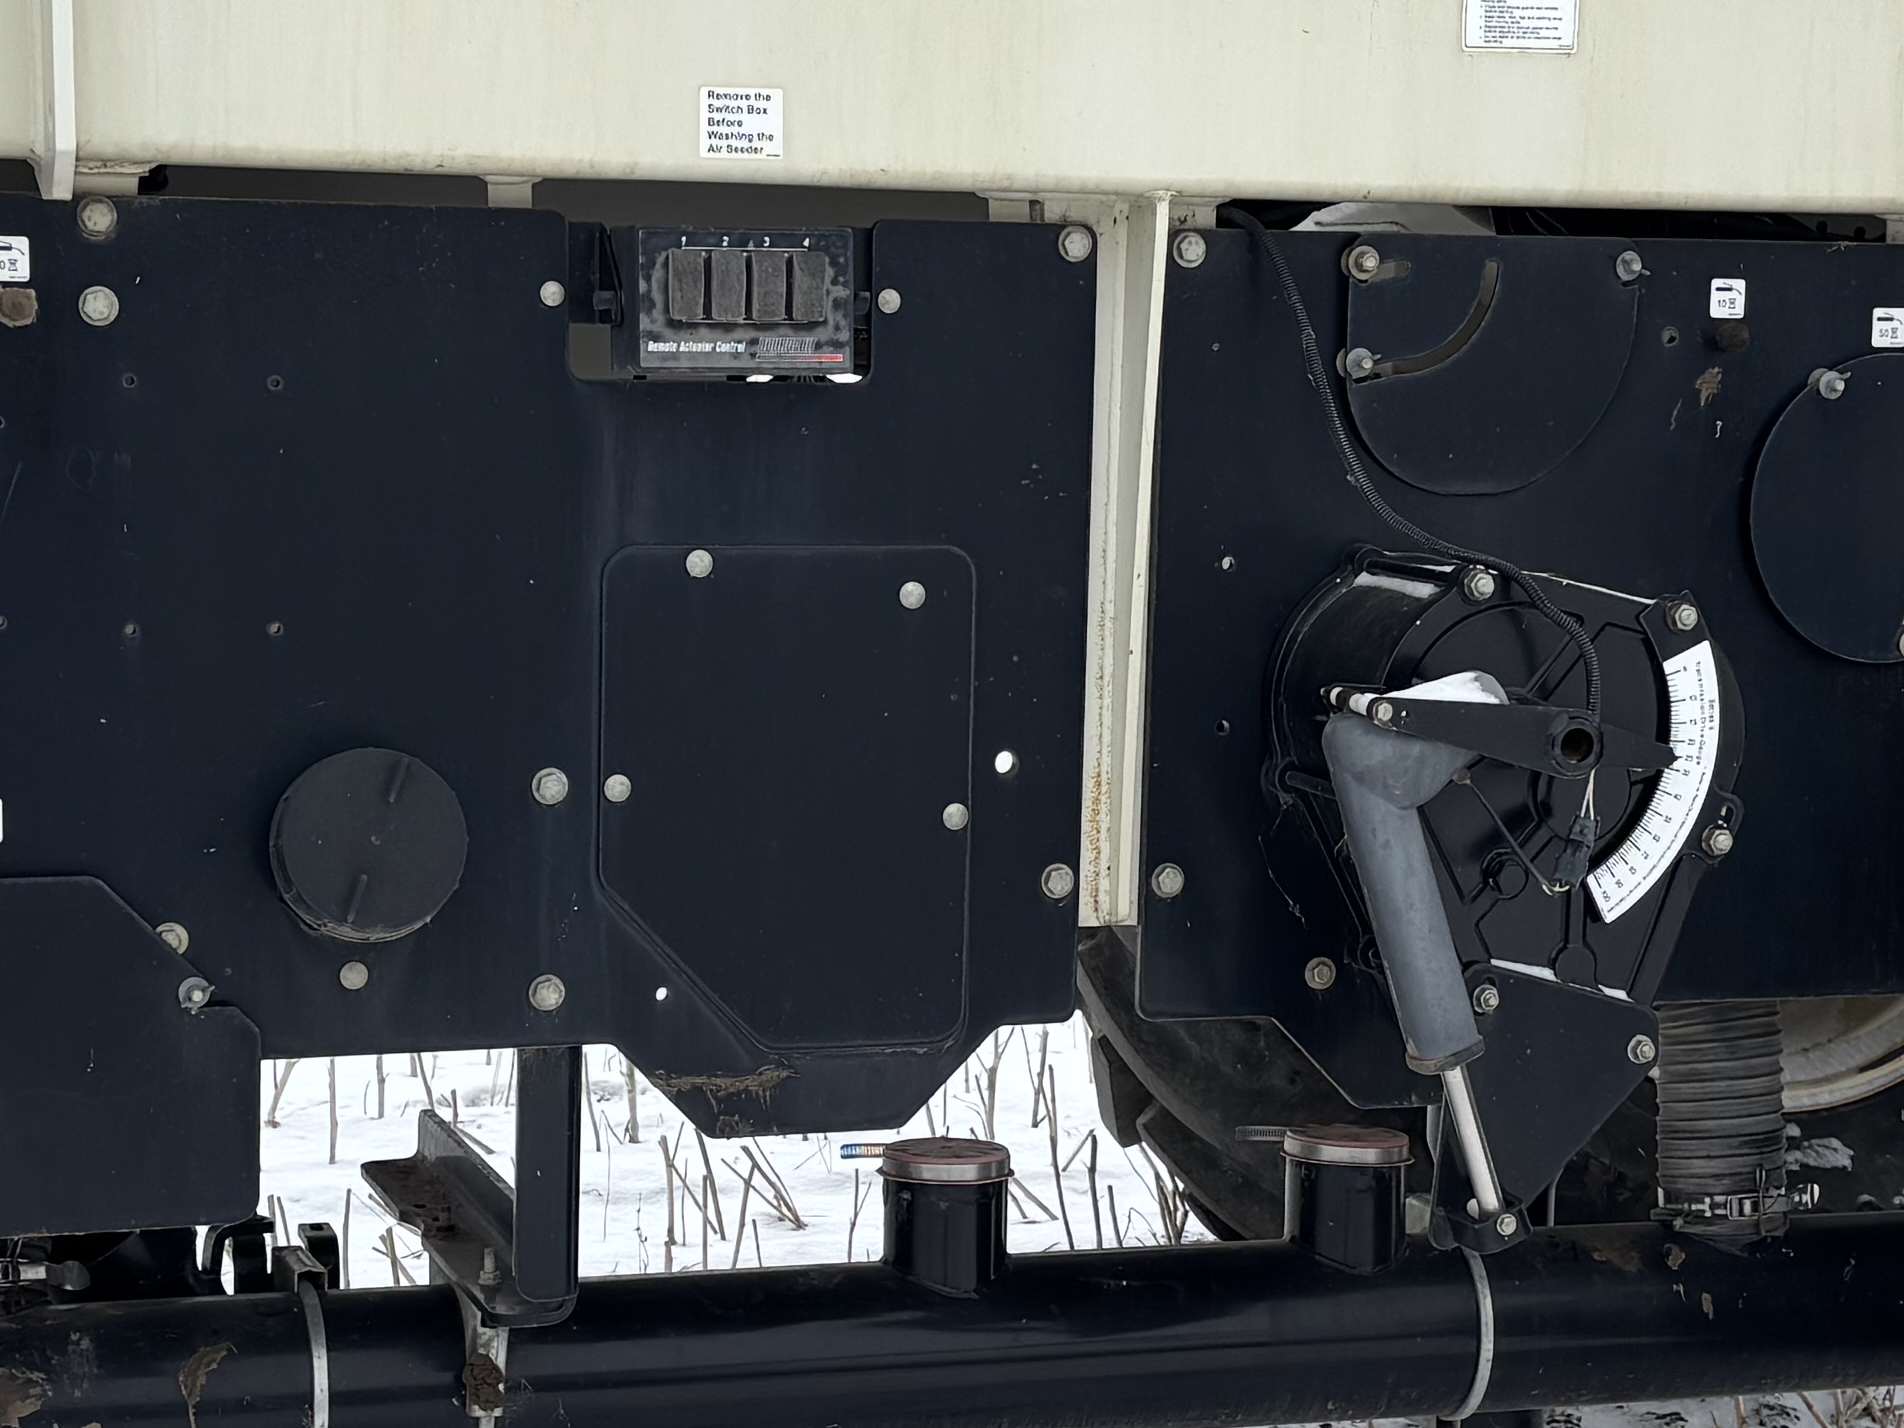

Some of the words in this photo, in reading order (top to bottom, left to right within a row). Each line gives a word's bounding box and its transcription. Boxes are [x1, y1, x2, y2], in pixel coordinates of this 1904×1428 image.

[707, 90, 751, 101] Remove
[754, 92, 772, 102] the
[707, 103, 744, 114] Switch
[747, 104, 768, 115] Box
[707, 117, 744, 128] Before
[707, 130, 754, 143] Washing
[757, 132, 774, 142] the
[707, 143, 723, 153] Air
[726, 144, 764, 154] Seeder
[802, 237, 810, 247] 4
[1718, 299, 1727, 308] 10
[648, 341, 678, 352] Remote
[680, 341, 714, 352] Actuator
[716, 341, 746, 353] Control
